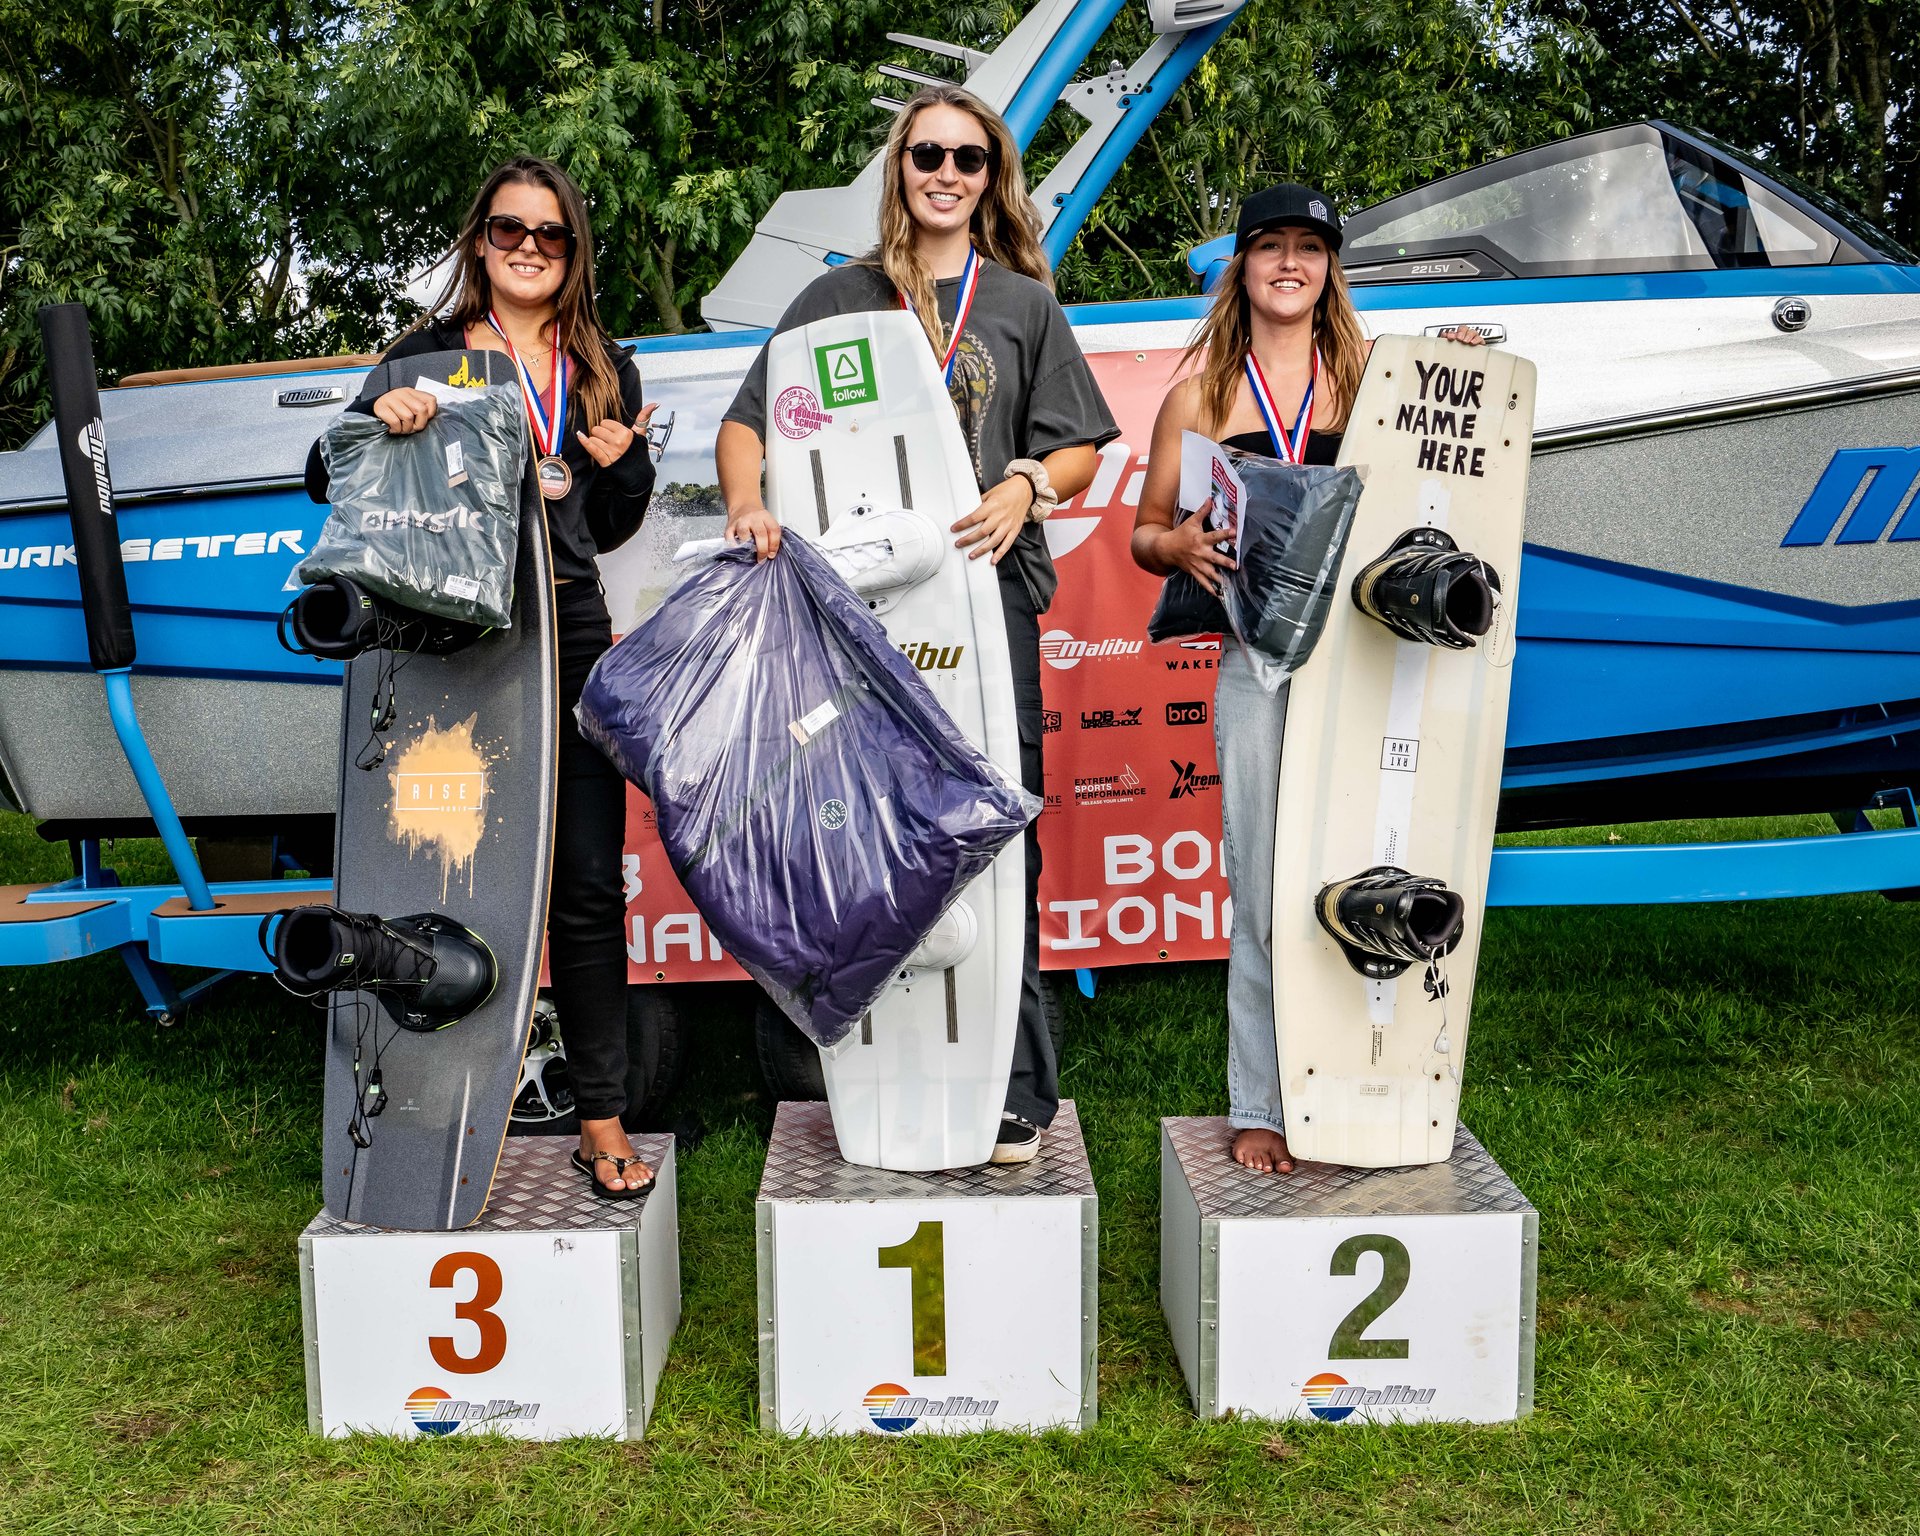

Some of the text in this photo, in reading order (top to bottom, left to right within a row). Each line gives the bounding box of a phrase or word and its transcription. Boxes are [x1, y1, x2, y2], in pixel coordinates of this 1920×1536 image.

[1411, 264, 1450, 274] 22LSV
[1415, 359, 1485, 409] YOUR
[794, 417, 822, 431] SCHOOL
[797, 408, 833, 424] BOARDING
[1395, 403, 1477, 439] NAME
[1417, 439, 1486, 478] HERE
[1058, 638, 1143, 657] Malibu
[1166, 659, 1222, 671] WAKE
[1081, 710, 1114, 722] LDB
[1169, 705, 1206, 722] bro!
[1392, 742, 1410, 753] RNX
[1074, 776, 1120, 786] EXTREME
[1074, 783, 1112, 793] SPORTS
[1169, 759, 1222, 799] Xtrem
[412, 783, 467, 800] RISE
[1075, 787, 1146, 800] PERFORMANCE
[1104, 830, 1227, 885] BO
[878, 1221, 947, 1376] 1
[1328, 1233, 1411, 1360] 2
[429, 1252, 507, 1374] 3
[1328, 1385, 1436, 1406] Malibu
[432, 1400, 541, 1420] Malibu
[889, 1397, 999, 1416] Malibu
